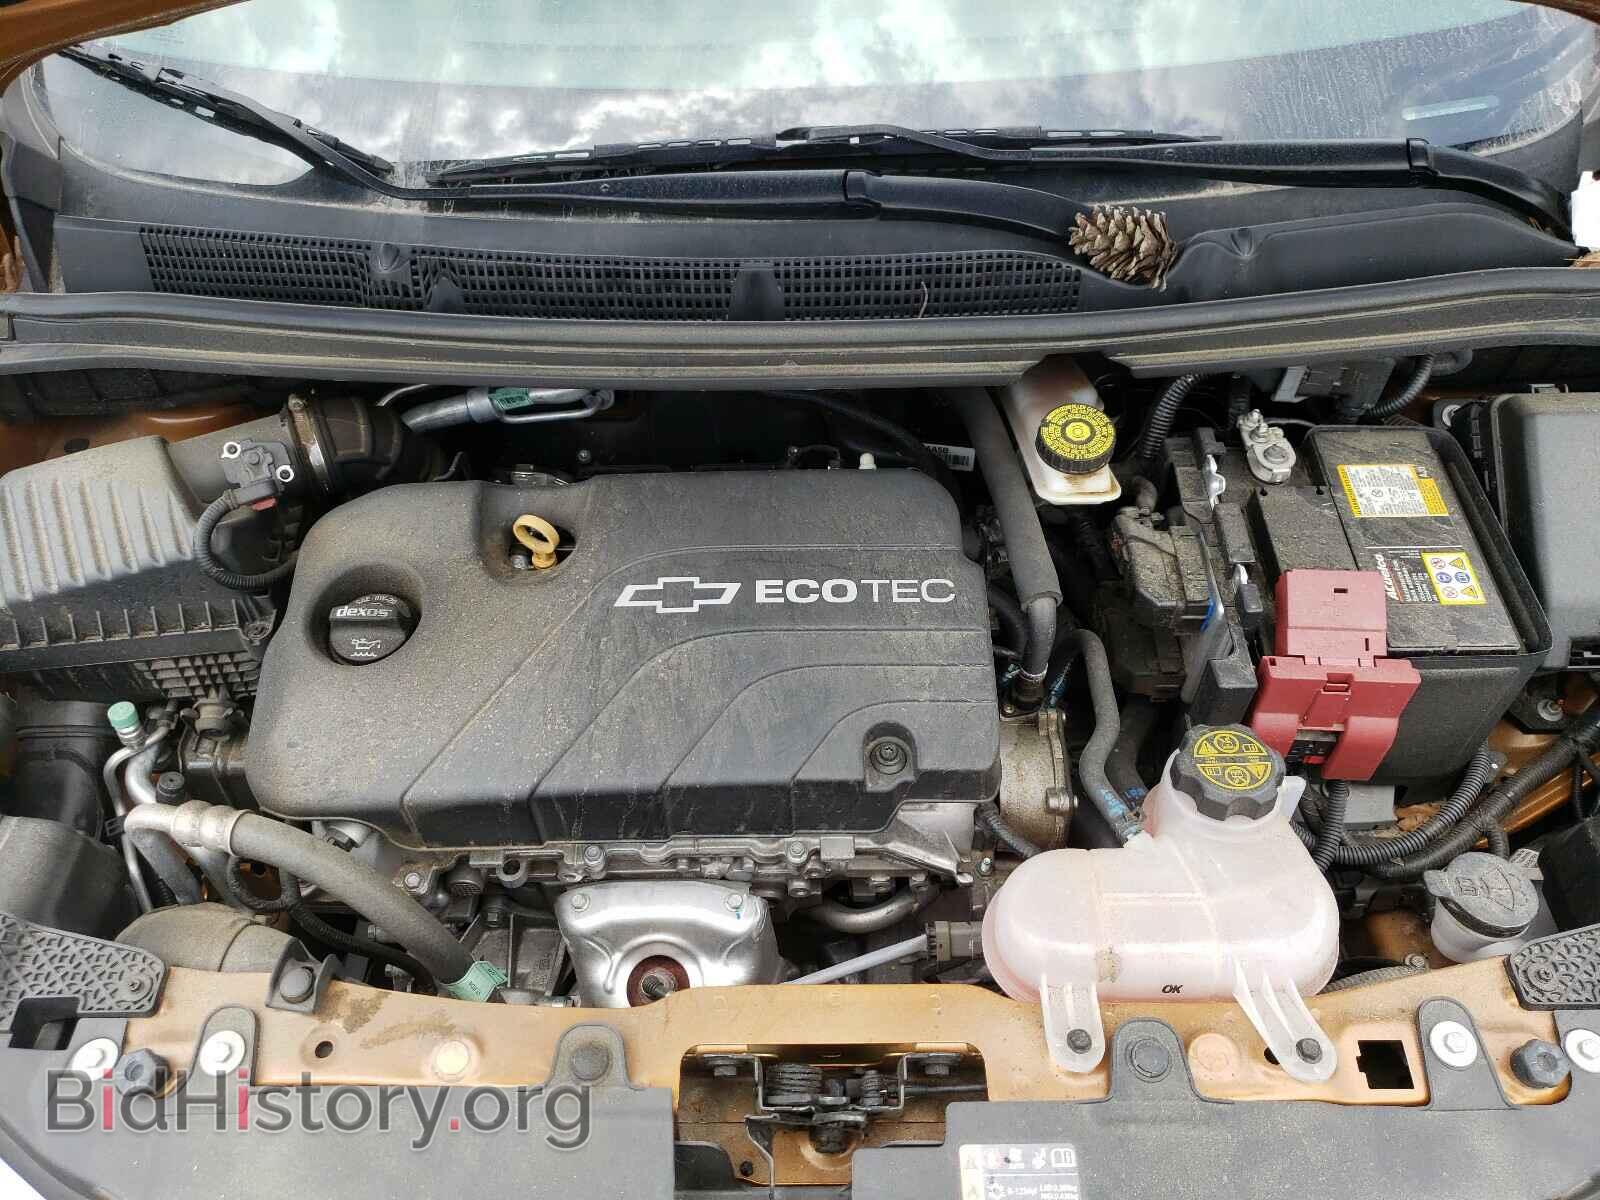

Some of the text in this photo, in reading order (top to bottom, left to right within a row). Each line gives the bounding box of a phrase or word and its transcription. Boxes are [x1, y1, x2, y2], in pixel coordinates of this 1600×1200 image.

[755, 579, 956, 603] ECOTEC
[336, 605, 393, 617] dexos
[1162, 984, 1183, 994] OK
